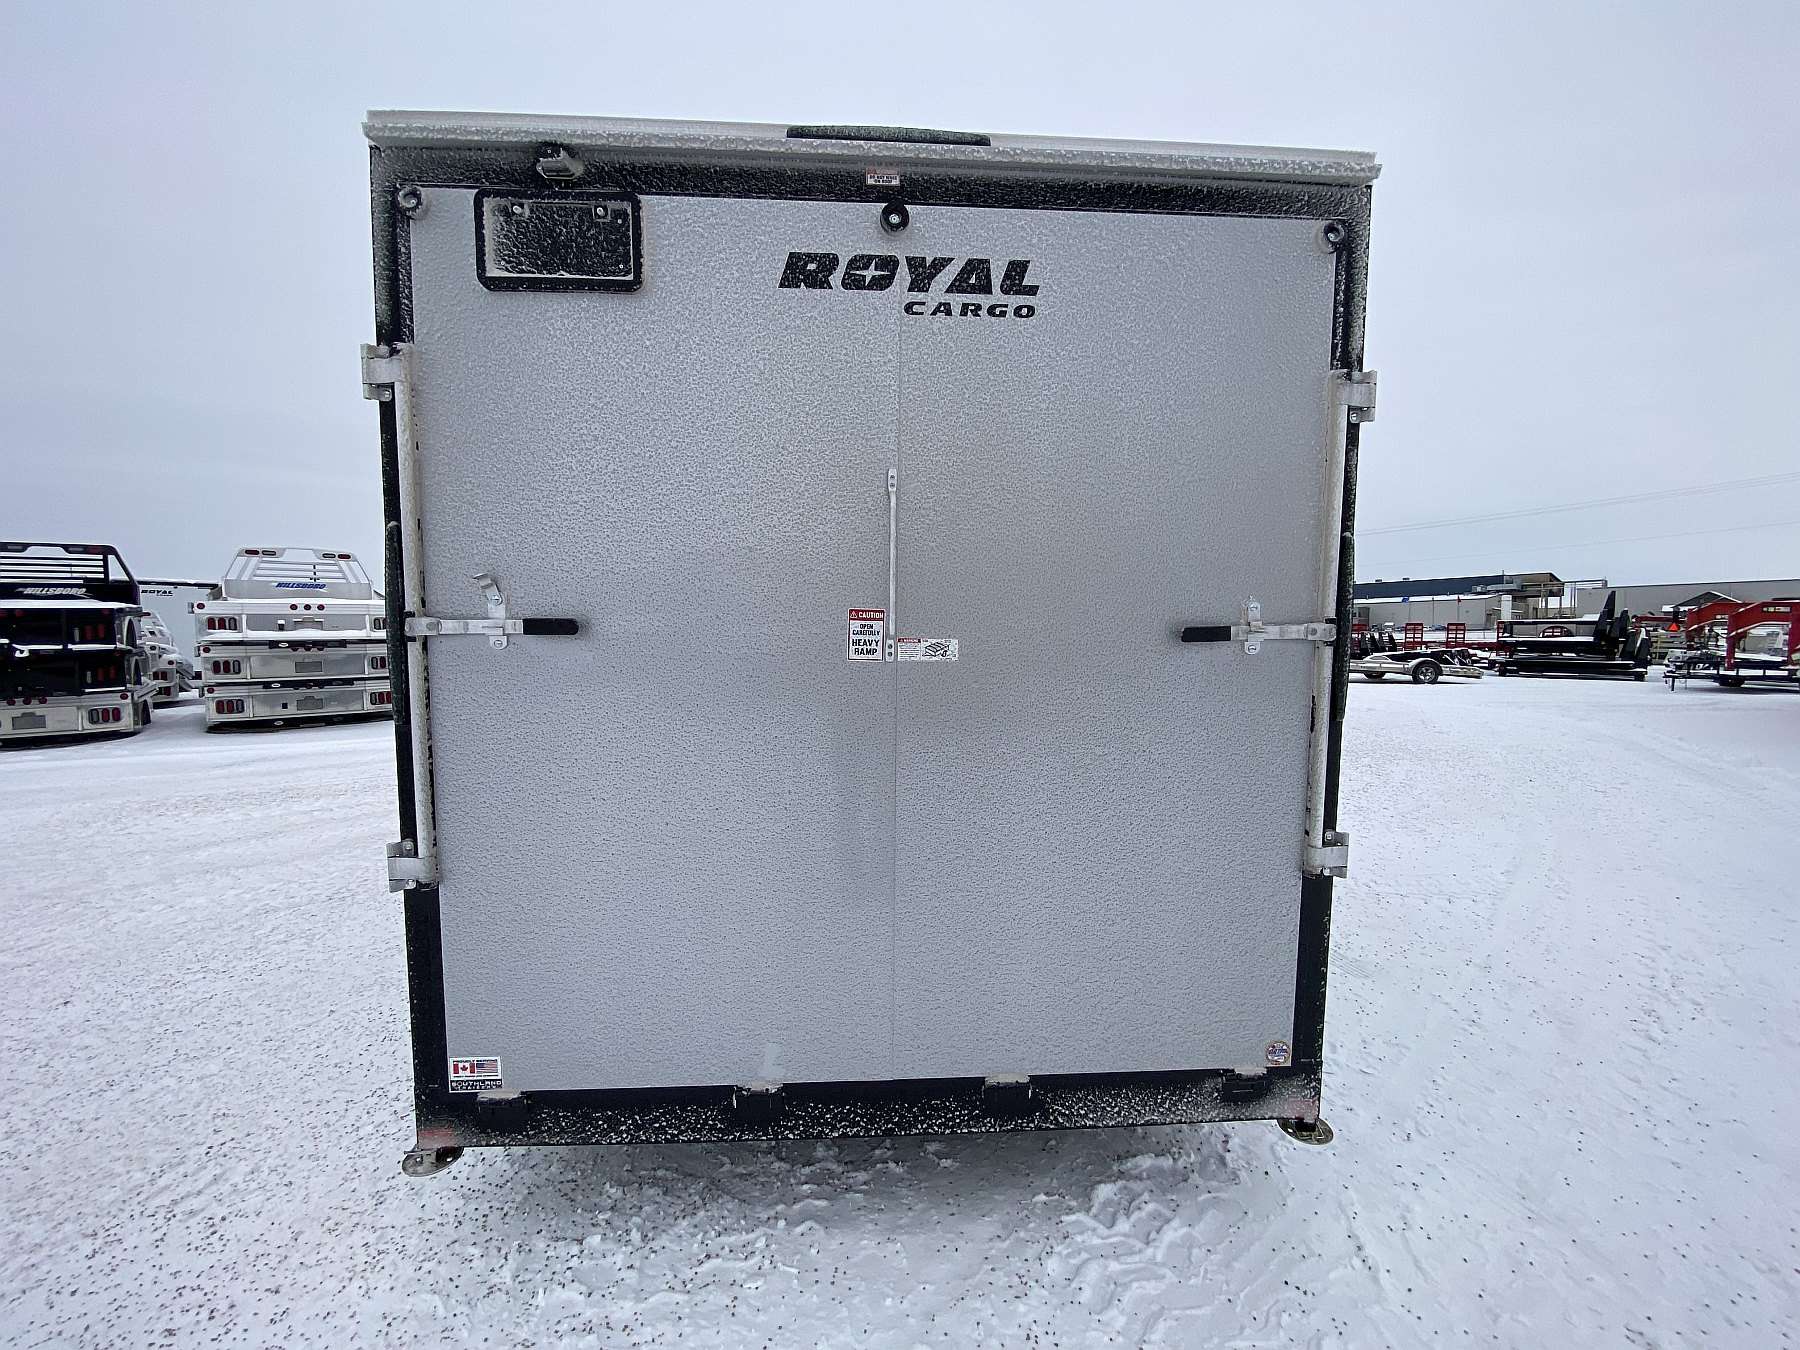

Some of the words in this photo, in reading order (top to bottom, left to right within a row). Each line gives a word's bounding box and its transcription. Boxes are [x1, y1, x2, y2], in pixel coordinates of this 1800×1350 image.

[778, 251, 1040, 296] ROYAL
[903, 301, 1036, 318] CARGO
[24, 587, 86, 595] HILLSBORO
[854, 647, 877, 655] RAMP
